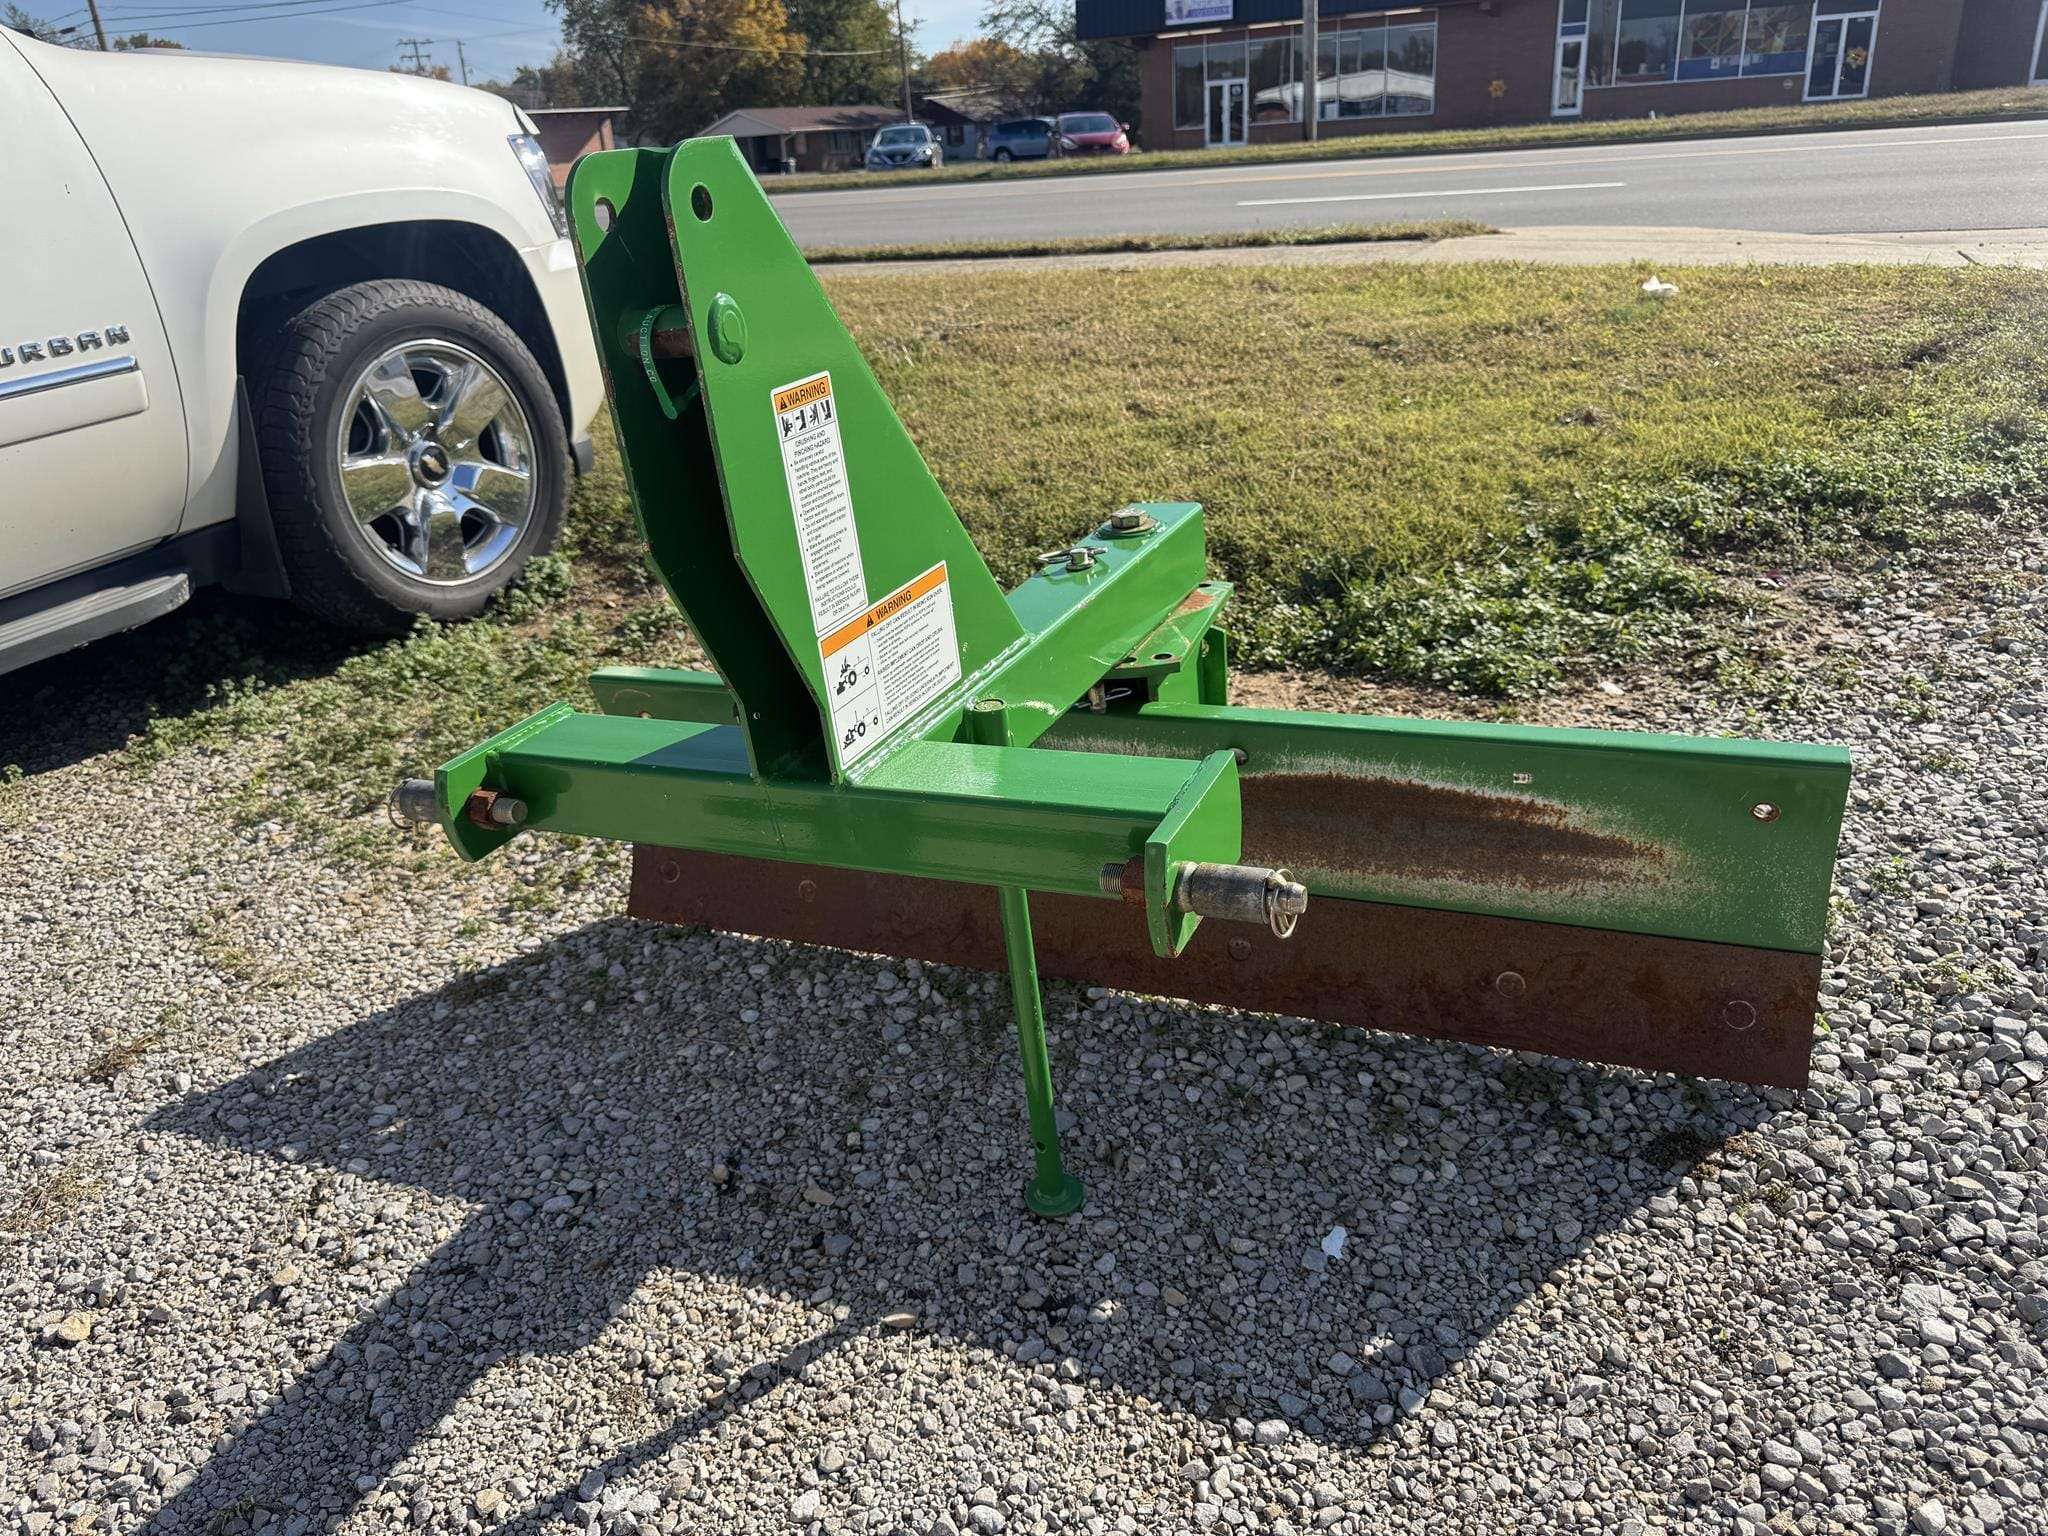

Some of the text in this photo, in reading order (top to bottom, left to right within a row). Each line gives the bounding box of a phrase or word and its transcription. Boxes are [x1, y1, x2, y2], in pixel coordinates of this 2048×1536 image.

[786, 381, 825, 406] WARNING
[816, 429, 825, 438] AND
[876, 589, 911, 621] WARNING
